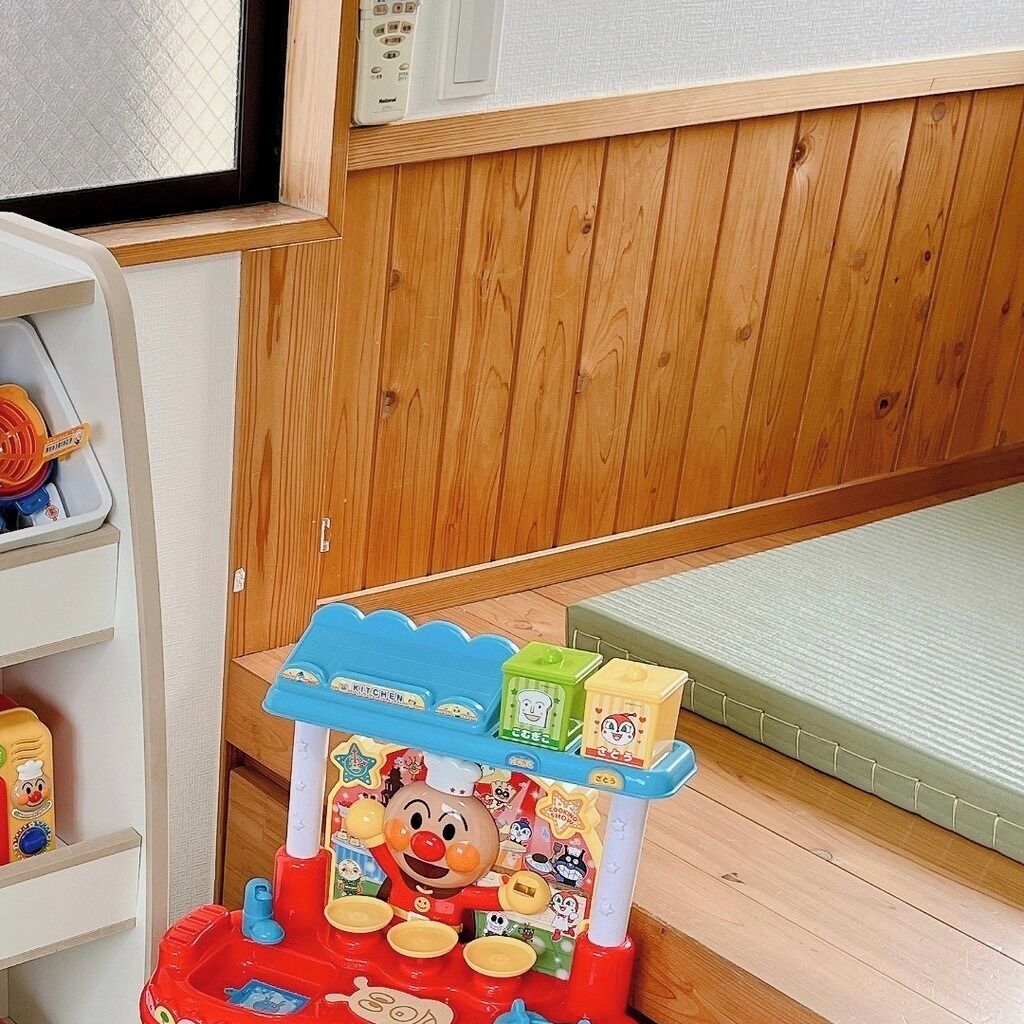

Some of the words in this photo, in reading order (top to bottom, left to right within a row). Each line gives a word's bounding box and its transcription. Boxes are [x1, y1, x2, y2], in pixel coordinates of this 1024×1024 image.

[353, 684, 403, 702] KITCHEN
[511, 727, 550, 744] こむぎこ
[596, 746, 633, 763] さとう
[549, 807, 578, 822] COOKING
[550, 812, 574, 825] SHOW
